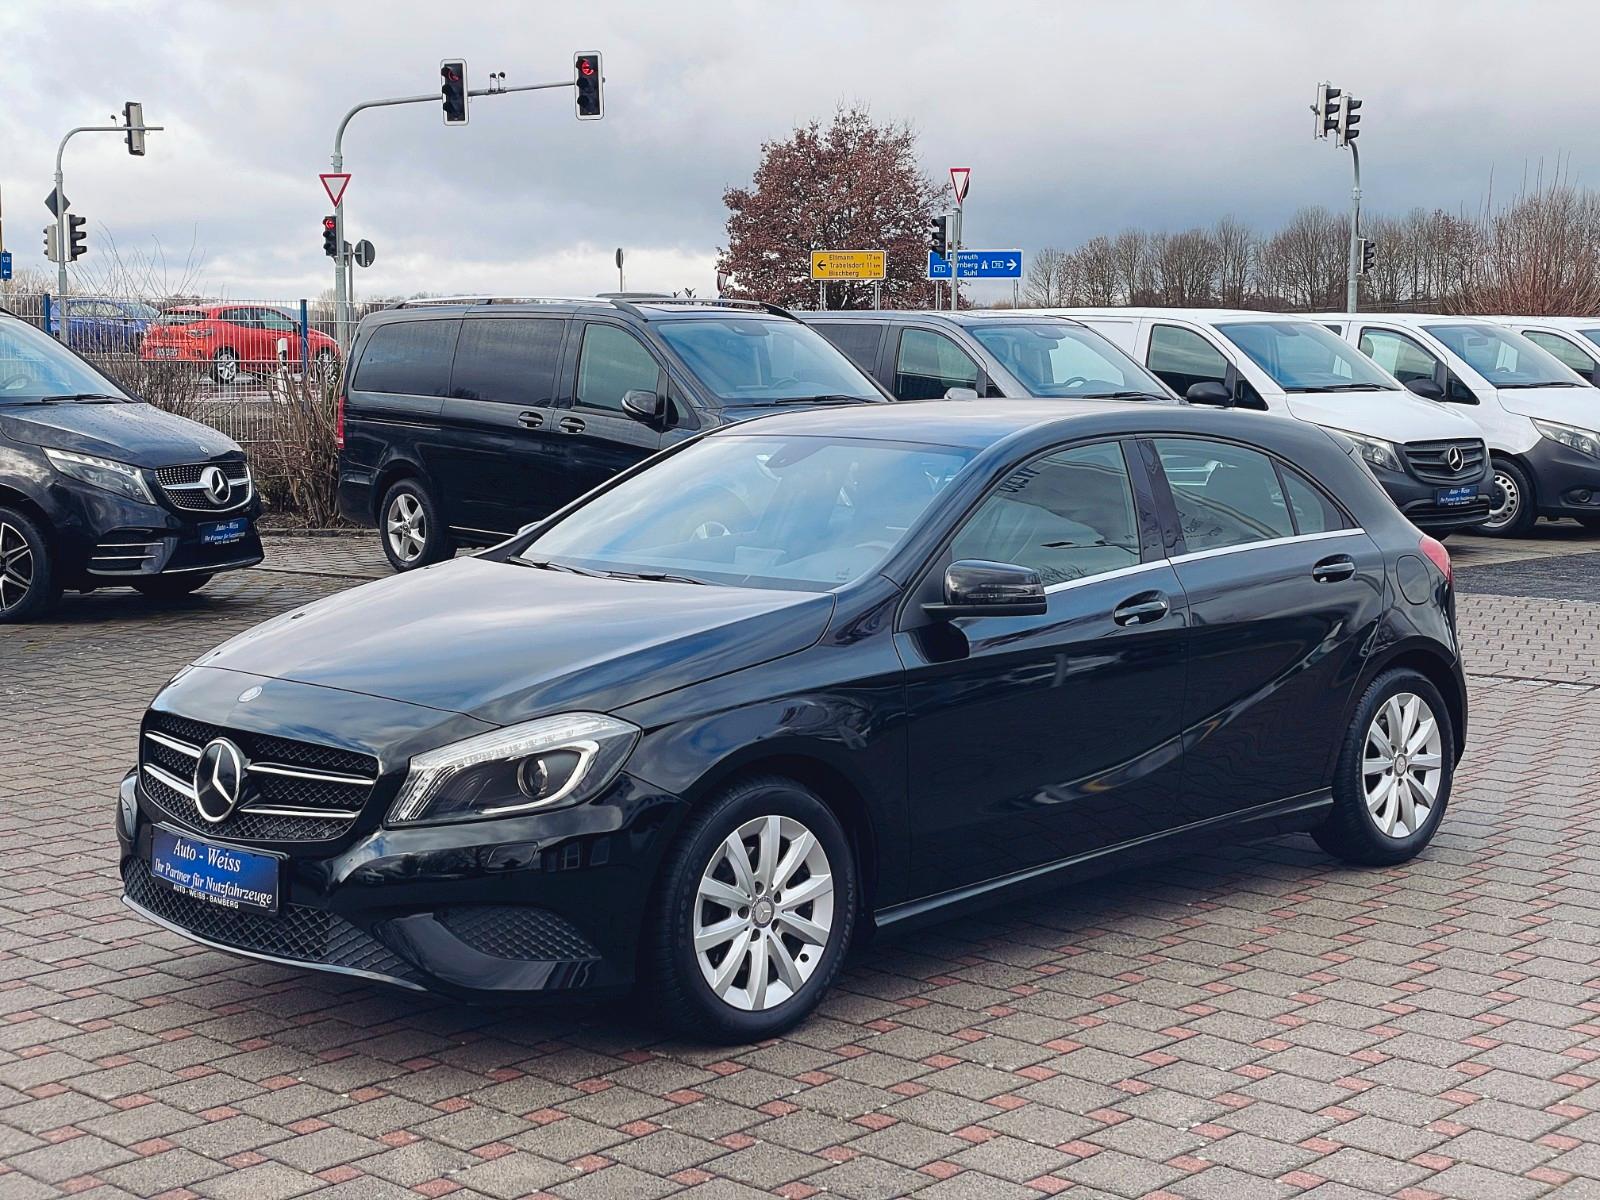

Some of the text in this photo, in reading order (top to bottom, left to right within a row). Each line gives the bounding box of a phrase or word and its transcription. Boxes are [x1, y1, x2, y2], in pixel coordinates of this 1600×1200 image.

[949, 253, 979, 261] Byreuth
[948, 261, 979, 270] Nrnberg
[828, 270, 860, 278] Bischberg
[963, 269, 978, 277] Suhl
[173, 838, 197, 860] Auto
[207, 847, 241, 873] Weiss
[154, 857, 273, 907] Ihr Partner für Nutzfahrzeuge
